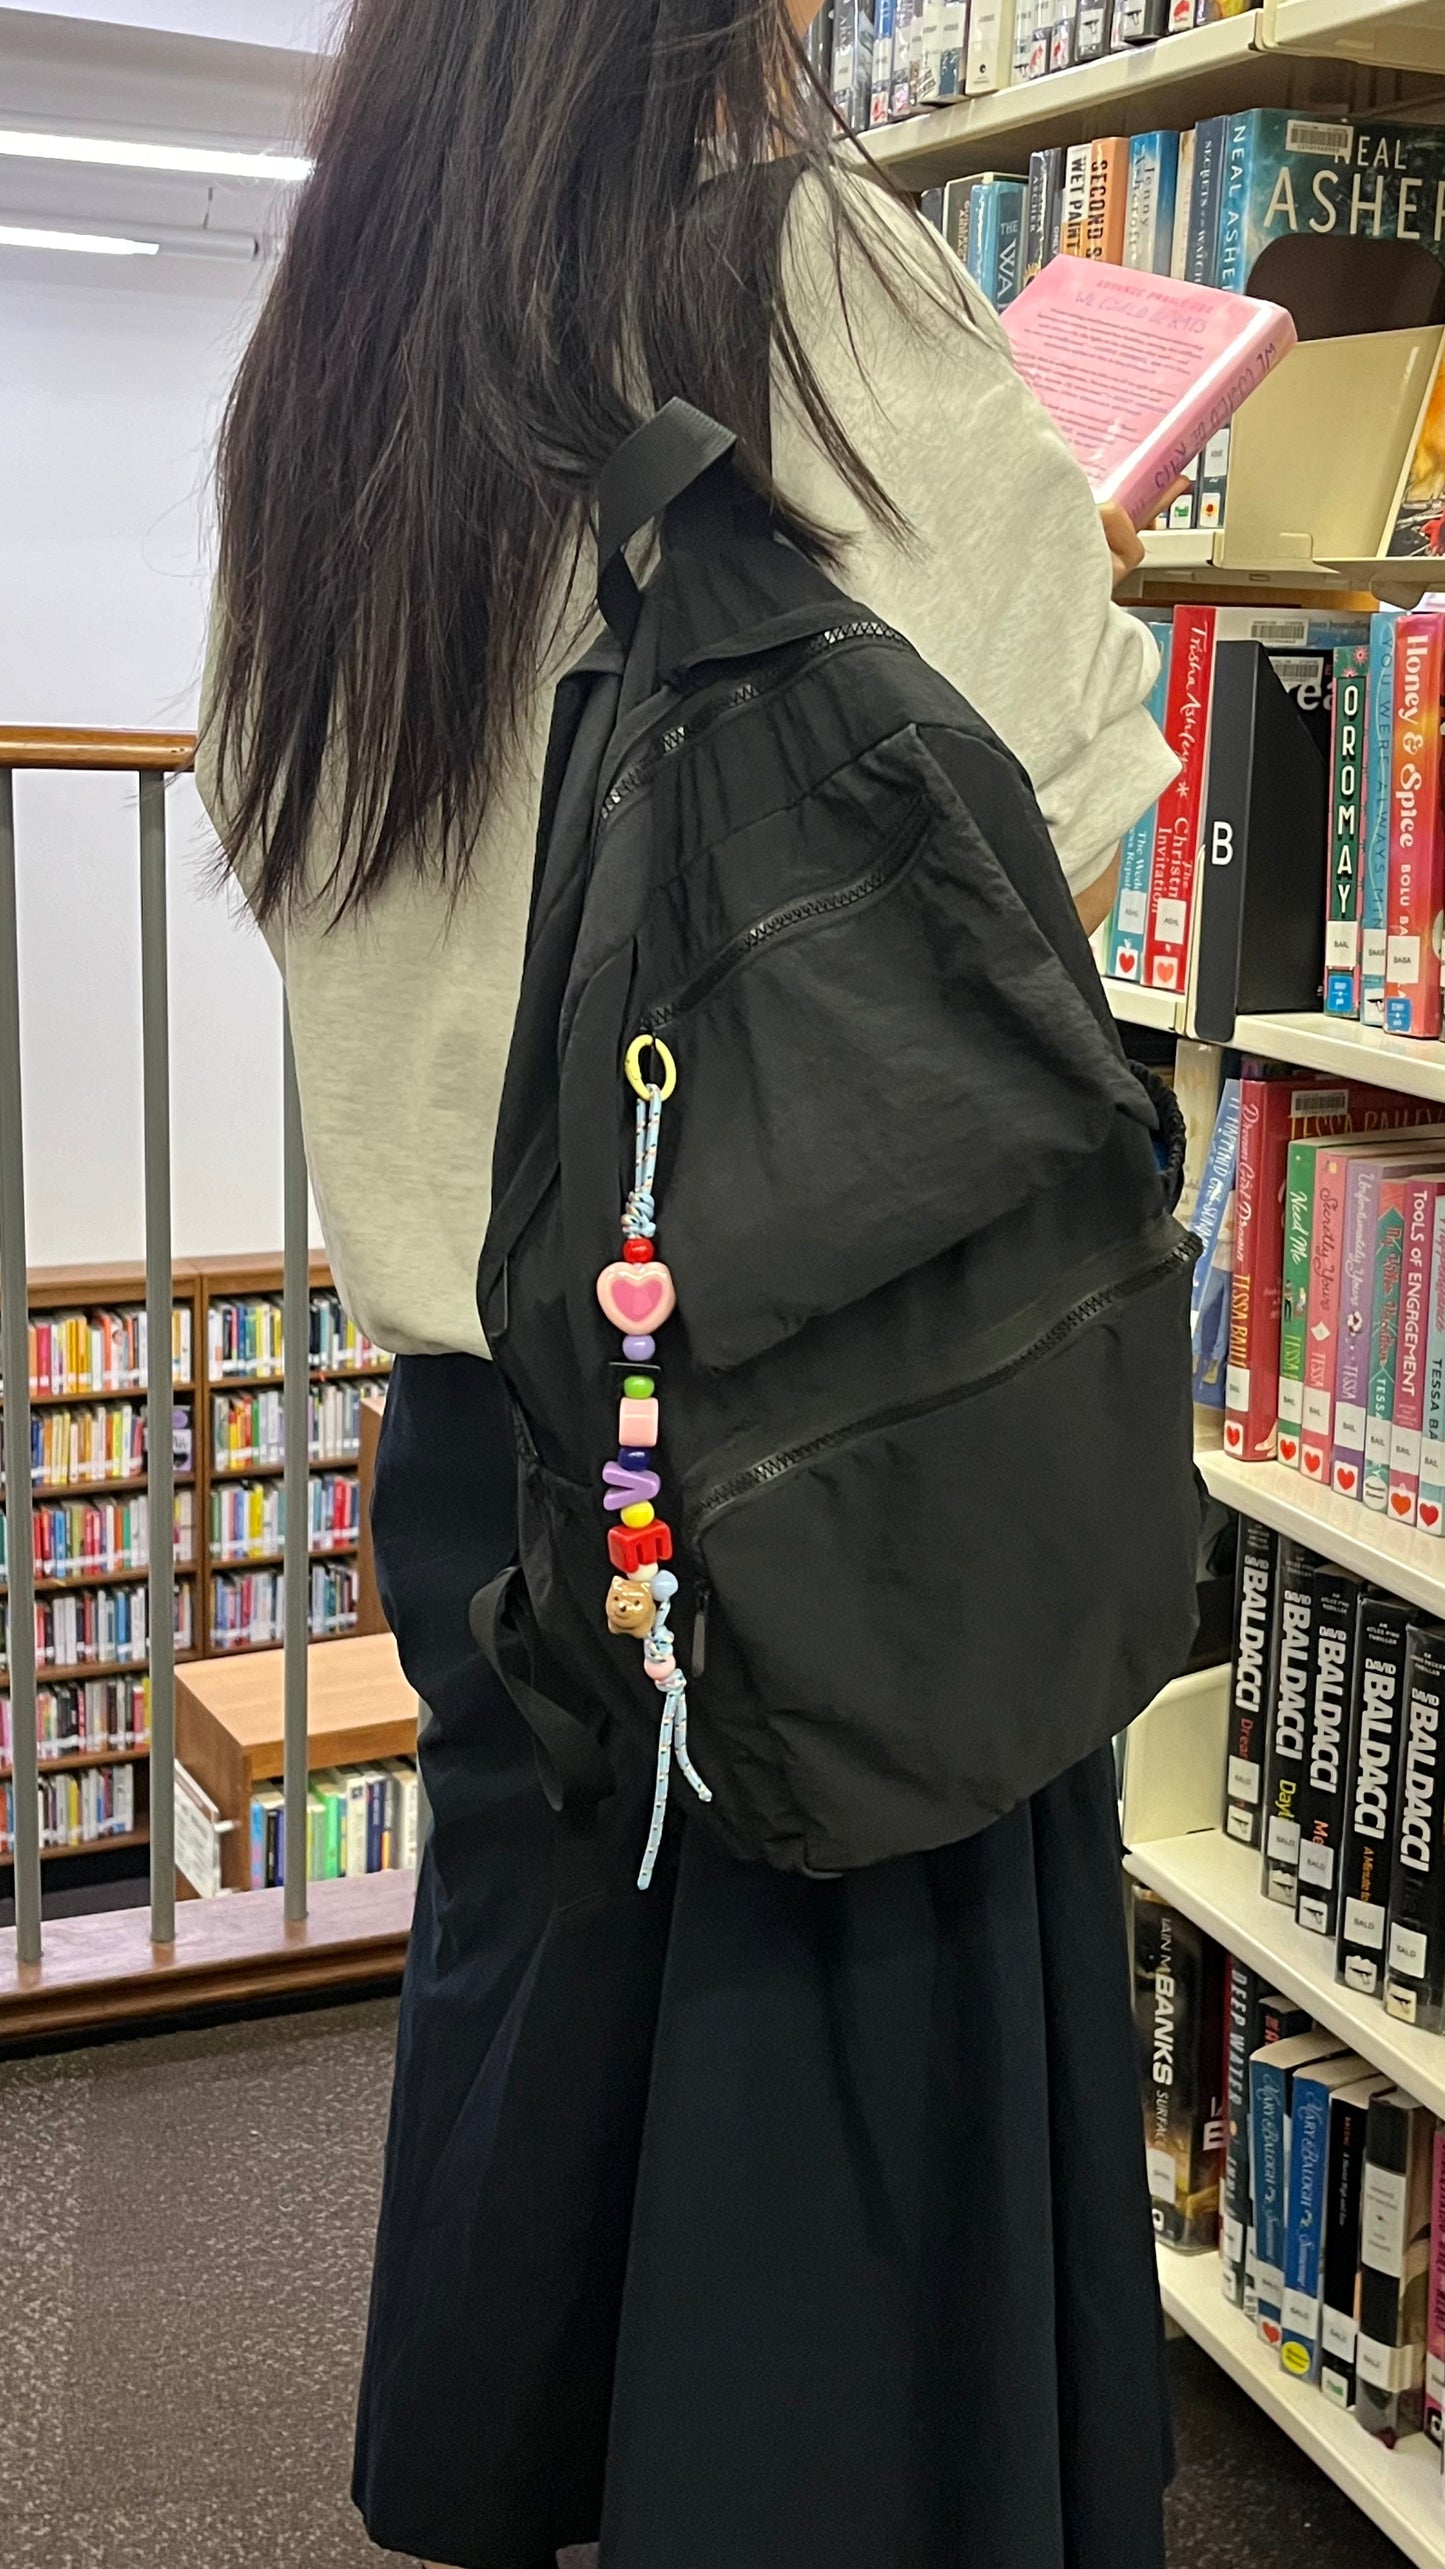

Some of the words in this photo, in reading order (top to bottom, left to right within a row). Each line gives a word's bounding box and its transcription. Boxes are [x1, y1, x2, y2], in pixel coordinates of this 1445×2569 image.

[1070, 157, 1085, 194] WET
[1199, 140, 1212, 207] SECRETS
[1228, 125, 1246, 198] NEAL
[1086, 160, 1107, 241] SECOND
[1141, 166, 1155, 228] Jenny
[1000, 219, 1018, 236] THE
[1066, 199, 1082, 250] PAINT
[1222, 211, 1240, 290] ASHE
[1187, 621, 1208, 692] Trisha
[1381, 641, 1393, 686] YOU
[1398, 635, 1429, 725] Honey
[1178, 693, 1202, 774] Ashley
[1377, 699, 1391, 767] WERE
[1402, 732, 1424, 755] &
[1337, 685, 1358, 913] OROMAY
[1395, 762, 1422, 848] Spice
[1137, 831, 1147, 855] The
[1212, 821, 1233, 866] B
[1375, 779, 1387, 873] ALWAYS
[1400, 864, 1412, 907] BOLU
[1242, 1103, 1260, 1160] Dream
[1239, 1161, 1256, 1200] Girl
[1236, 1203, 1252, 1263] Drama
[1290, 1191, 1309, 1236] Need
[1315, 1187, 1338, 1258] Secretly
[1410, 1190, 1427, 1241] TOOLS
[1290, 1236, 1308, 1265] Me
[1409, 1247, 1422, 1267] OF
[1231, 1273, 1251, 1320] TESSA
[1313, 1256, 1335, 1311] Yours
[1345, 1259, 1365, 1307] Yours
[1284, 1334, 1301, 1371] TESSA
[1401, 1272, 1422, 1397] ENGAGEMENT
[1310, 1352, 1326, 1388] TESSA
[1342, 1365, 1358, 1399] TESSA
[1430, 1359, 1444, 1411] TESSA
[1244, 1554, 1269, 1570] DAVID
[1284, 1590, 1311, 1606] DAVID
[1235, 1566, 1269, 1713] BALDACCI
[1319, 1626, 1347, 1641] DAVID
[1276, 1602, 1311, 1760] BALDACCI
[1365, 1658, 1397, 1675] DAVID
[1310, 1638, 1346, 1794] BALDACCI
[1411, 1687, 1439, 1706] DAVID
[1354, 1671, 1395, 1840] BALDACCI
[1400, 1701, 1438, 1872] BALDACCI
[1160, 1917, 1172, 1951] IAIN
[1354, 1918, 1375, 1930] BALD
[1396, 1945, 1416, 1958] BALD
[1231, 1969, 1247, 2027] DEEP
[1152, 1972, 1175, 2086] BANKS
[1229, 2032, 1245, 2106] WATER
